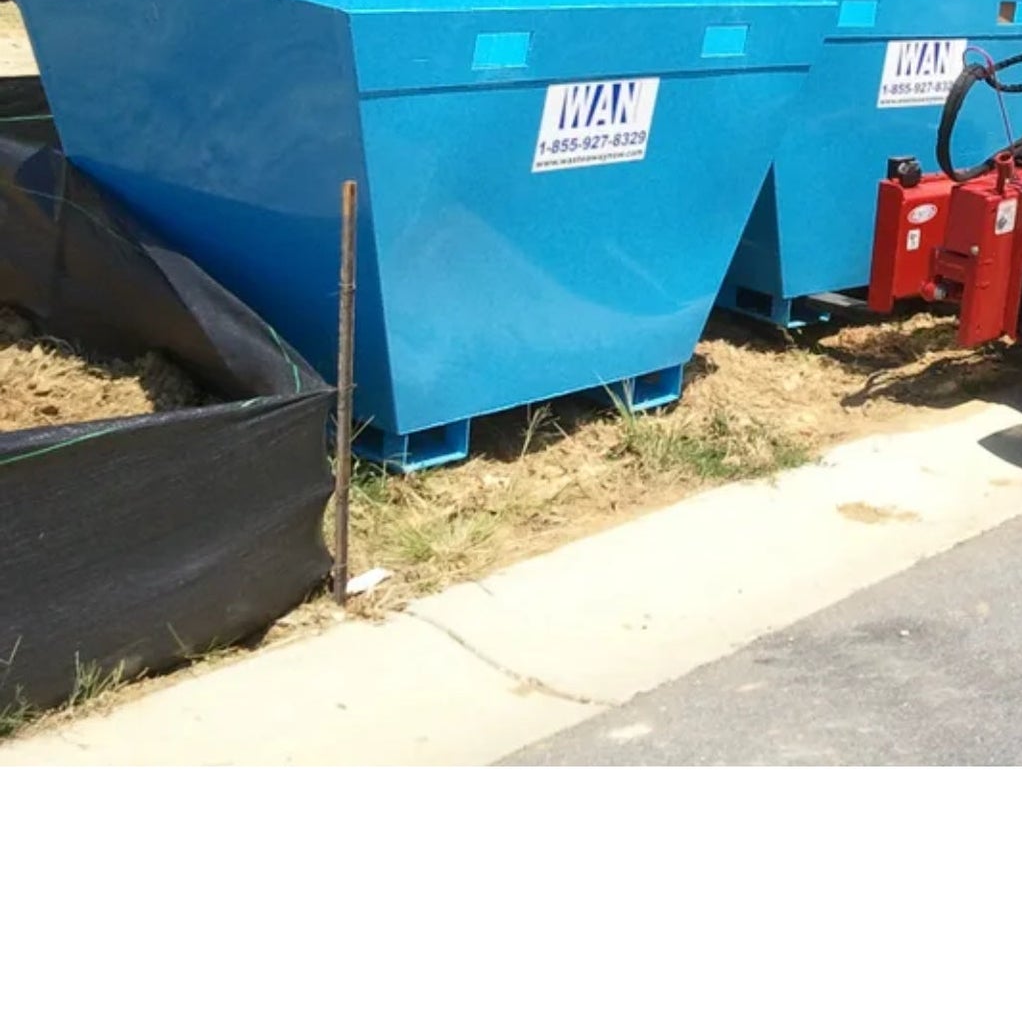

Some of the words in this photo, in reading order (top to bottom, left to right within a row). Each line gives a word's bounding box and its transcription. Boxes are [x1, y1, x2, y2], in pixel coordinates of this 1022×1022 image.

[895, 42, 953, 77] WAN
[558, 81, 643, 130] WAN
[539, 130, 647, 155] 1-855-927-8329
